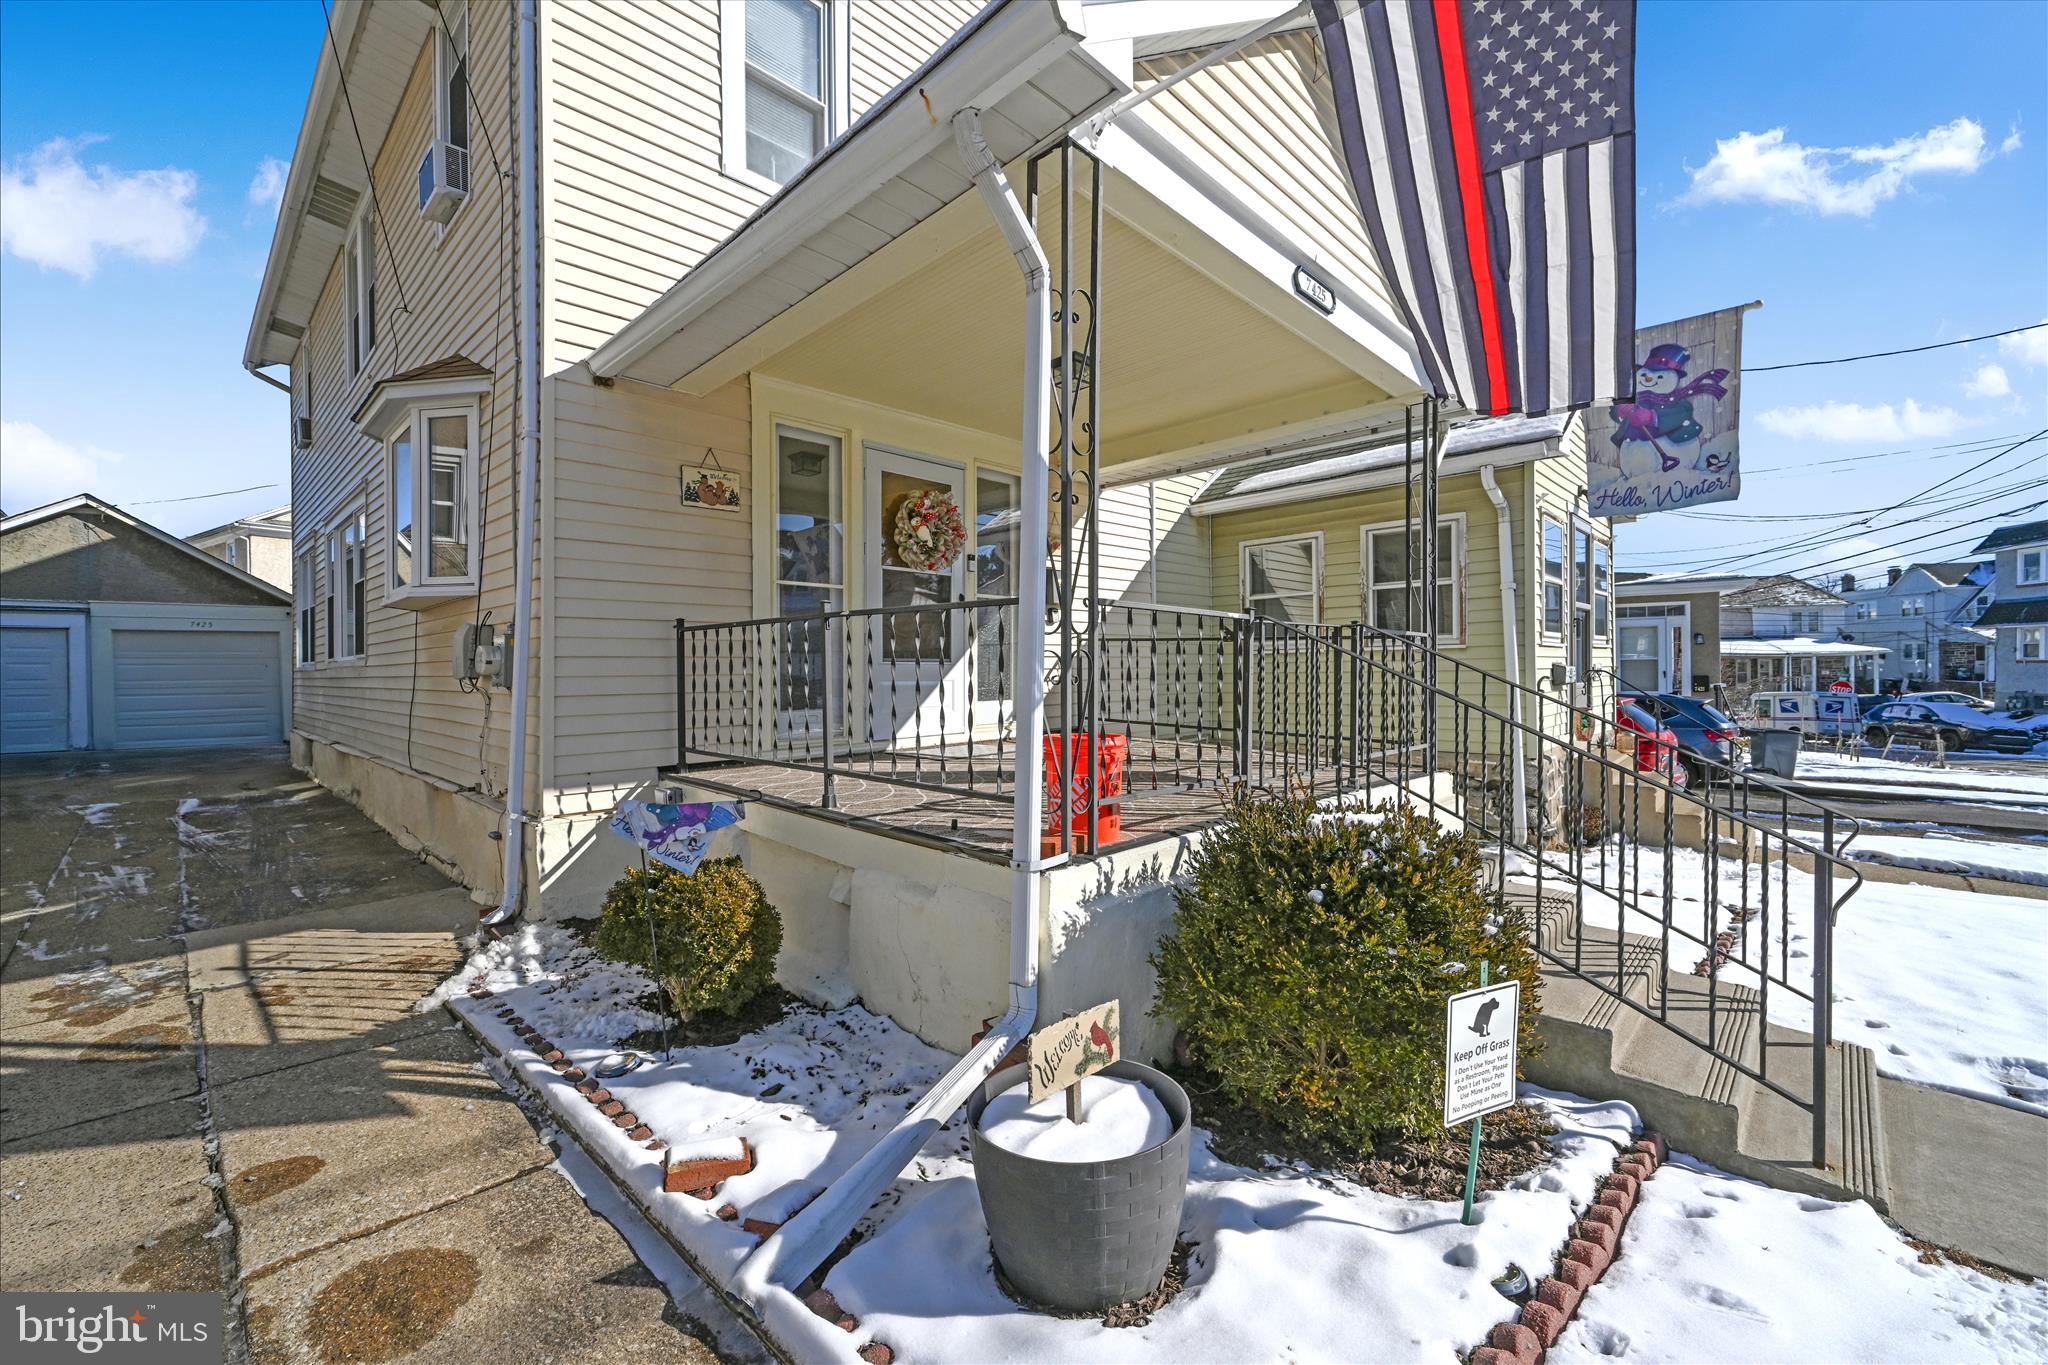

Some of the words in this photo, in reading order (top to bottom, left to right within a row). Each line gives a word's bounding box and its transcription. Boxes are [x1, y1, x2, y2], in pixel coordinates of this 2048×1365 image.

[1594, 486, 1647, 510] Hello,
[1652, 470, 1734, 507] Winter!
[1831, 685, 1852, 693] STOP
[1454, 1050, 1474, 1063] Keep
[1475, 1042, 1488, 1055] Off
[1490, 1039, 1509, 1051] Grass
[1458, 1065, 1473, 1075] Don't
[1484, 1058, 1496, 1066] Your
[1497, 1053, 1508, 1062] Yard
[1492, 1063, 1509, 1072] Please
[1457, 1082, 1472, 1093] Don't
[1472, 1079, 1481, 1087] Let
[1481, 1075, 1493, 1084] Your
[1494, 1072, 1505, 1080] Pets
[1470, 1088, 1484, 1097] Mine
[1491, 1081, 1502, 1089] One
[1452, 1105, 1461, 1114] No
[1491, 1091, 1508, 1100] Peeing
